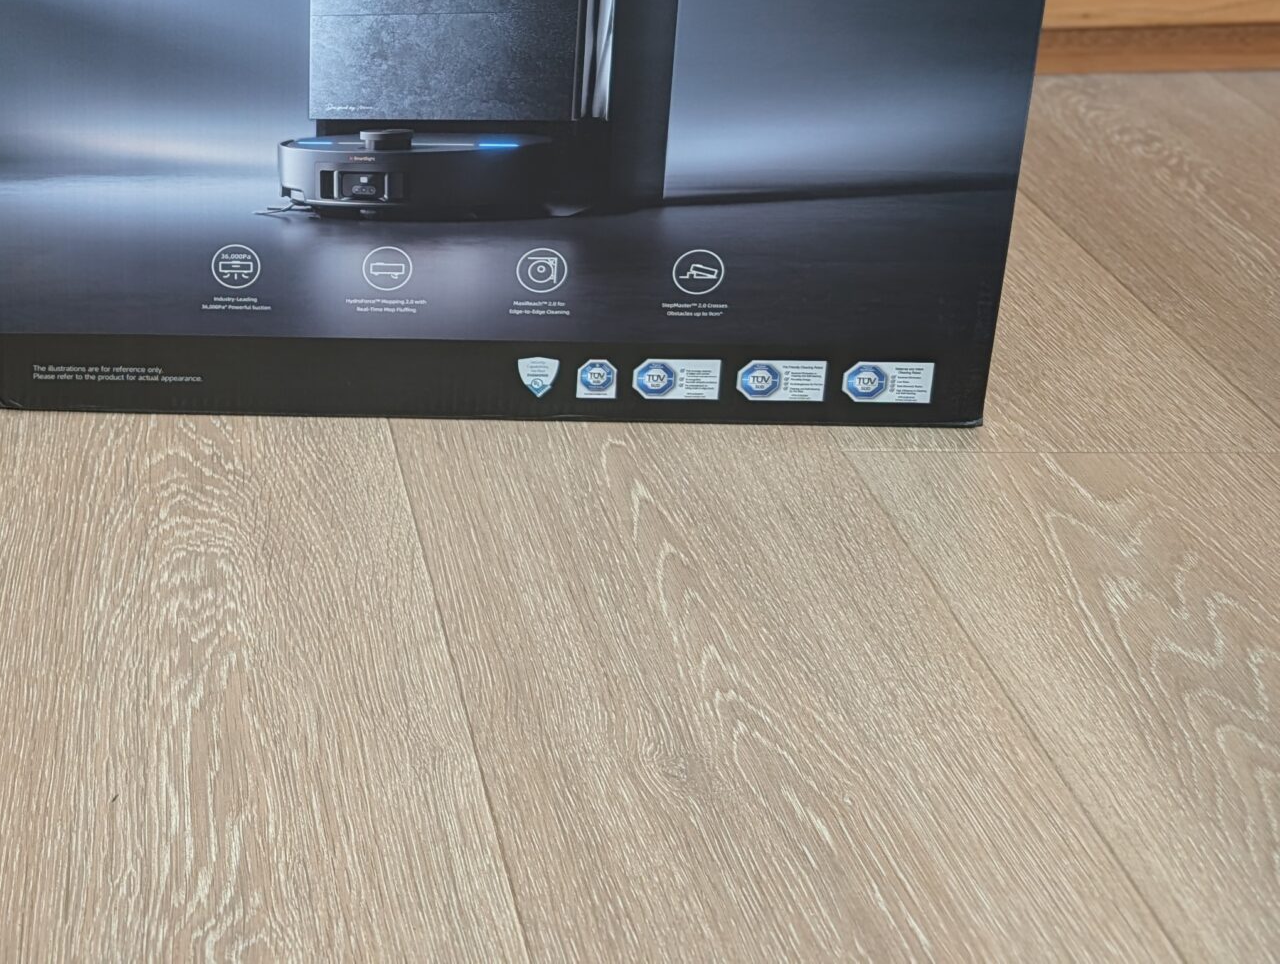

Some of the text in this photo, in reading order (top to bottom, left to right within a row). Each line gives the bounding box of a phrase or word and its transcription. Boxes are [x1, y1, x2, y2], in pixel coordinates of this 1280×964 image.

[48, 365, 86, 373] illustrations
[101, 365, 111, 373] for
[97, 373, 124, 382] product
[160, 375, 203, 383] appearance.
